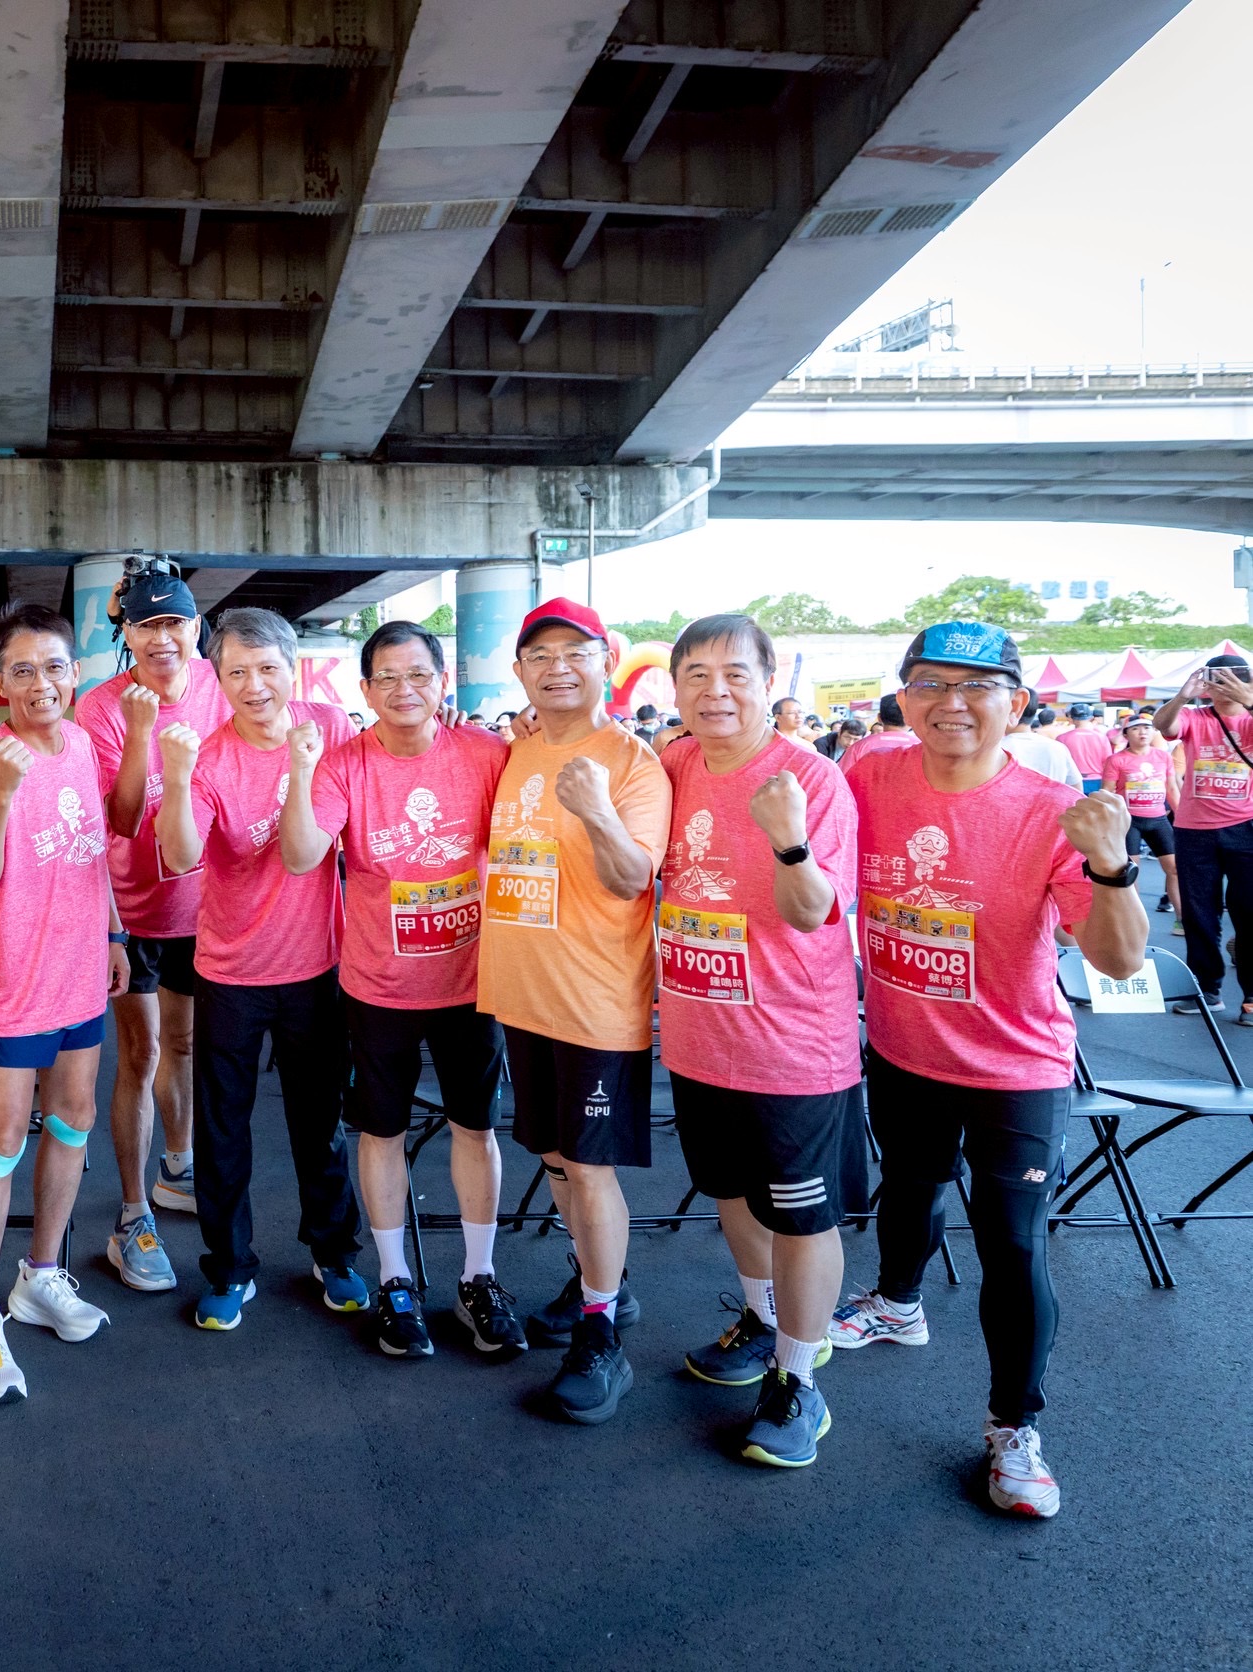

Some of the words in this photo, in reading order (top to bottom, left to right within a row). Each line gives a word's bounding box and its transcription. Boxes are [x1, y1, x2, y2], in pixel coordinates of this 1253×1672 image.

[944, 642, 980, 654] 2018
[497, 877, 553, 901] 39005
[397, 904, 480, 936] 甲19003
[660, 942, 740, 977] 甲19001
[868, 932, 967, 976] 甲19008
[1098, 977, 1150, 995] 貴賓席
[584, 1105, 611, 1118] CPU
